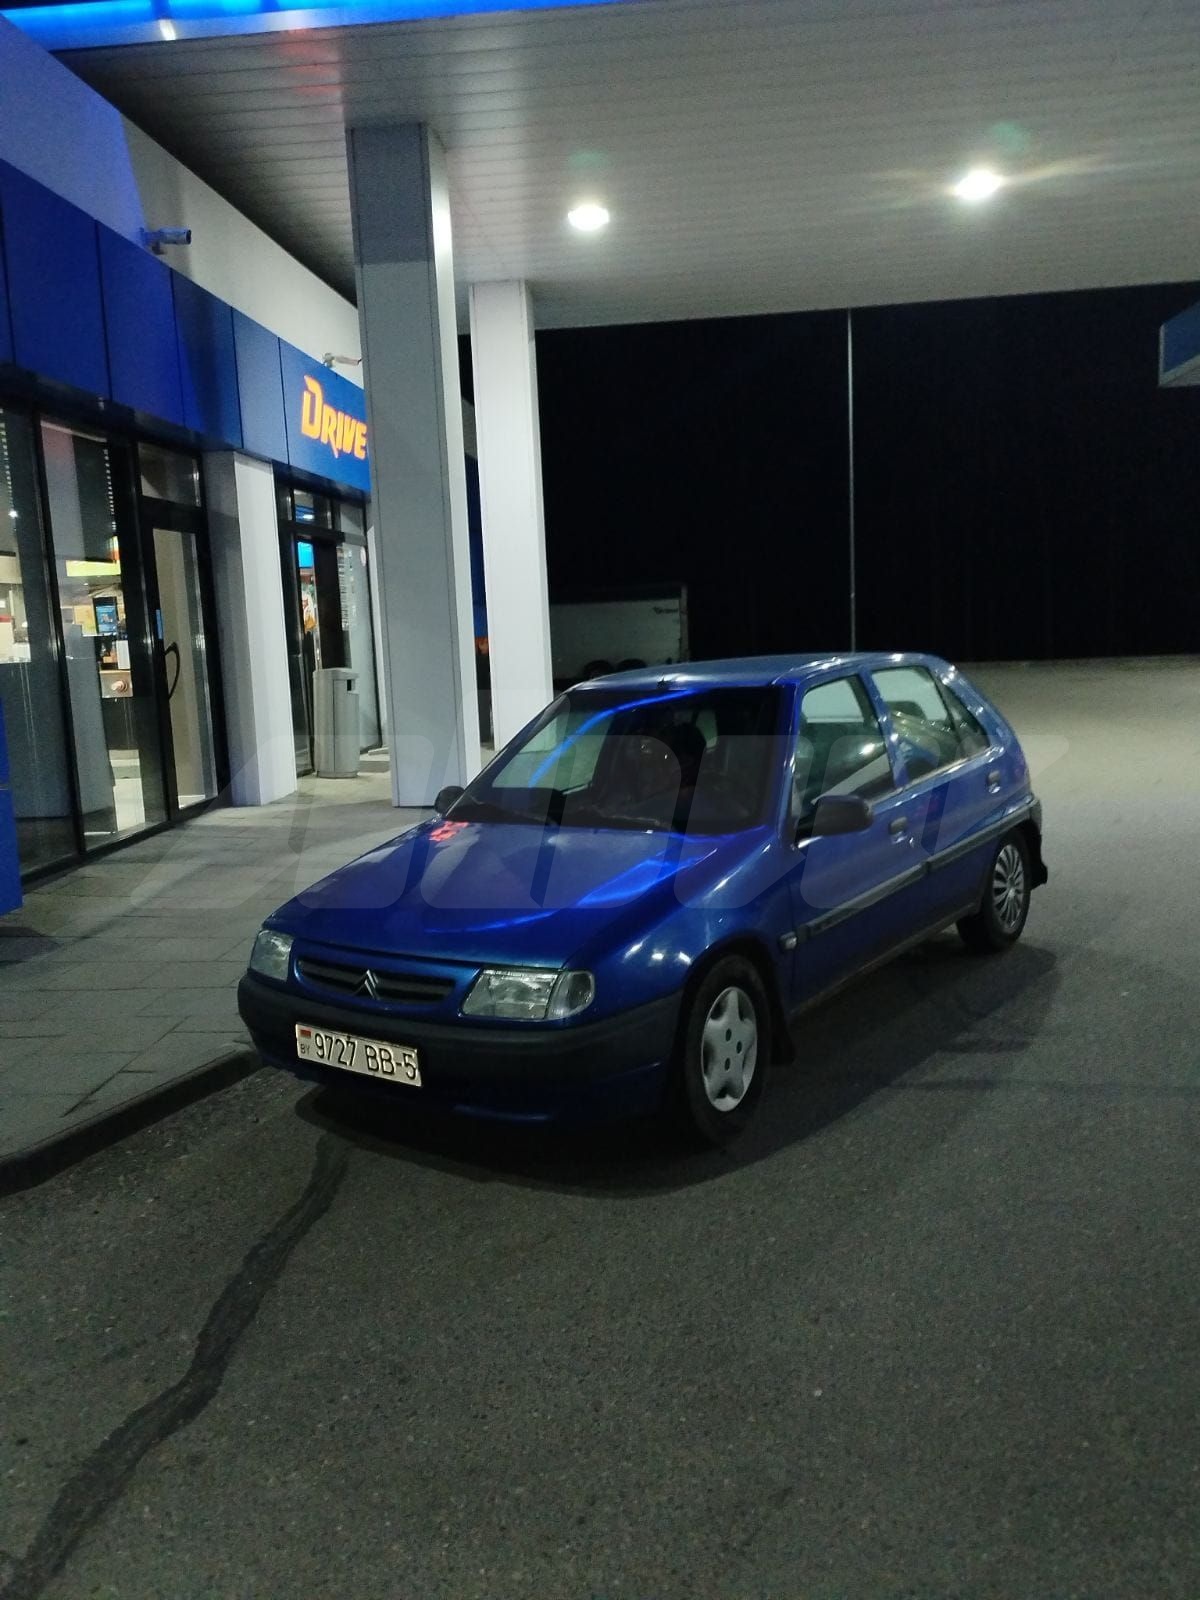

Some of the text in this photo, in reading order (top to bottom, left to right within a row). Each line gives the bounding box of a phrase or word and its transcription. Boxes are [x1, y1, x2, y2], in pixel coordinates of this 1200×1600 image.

[301, 374, 367, 460] DRIVE
[314, 1032, 417, 1080] 9727 BB-5
